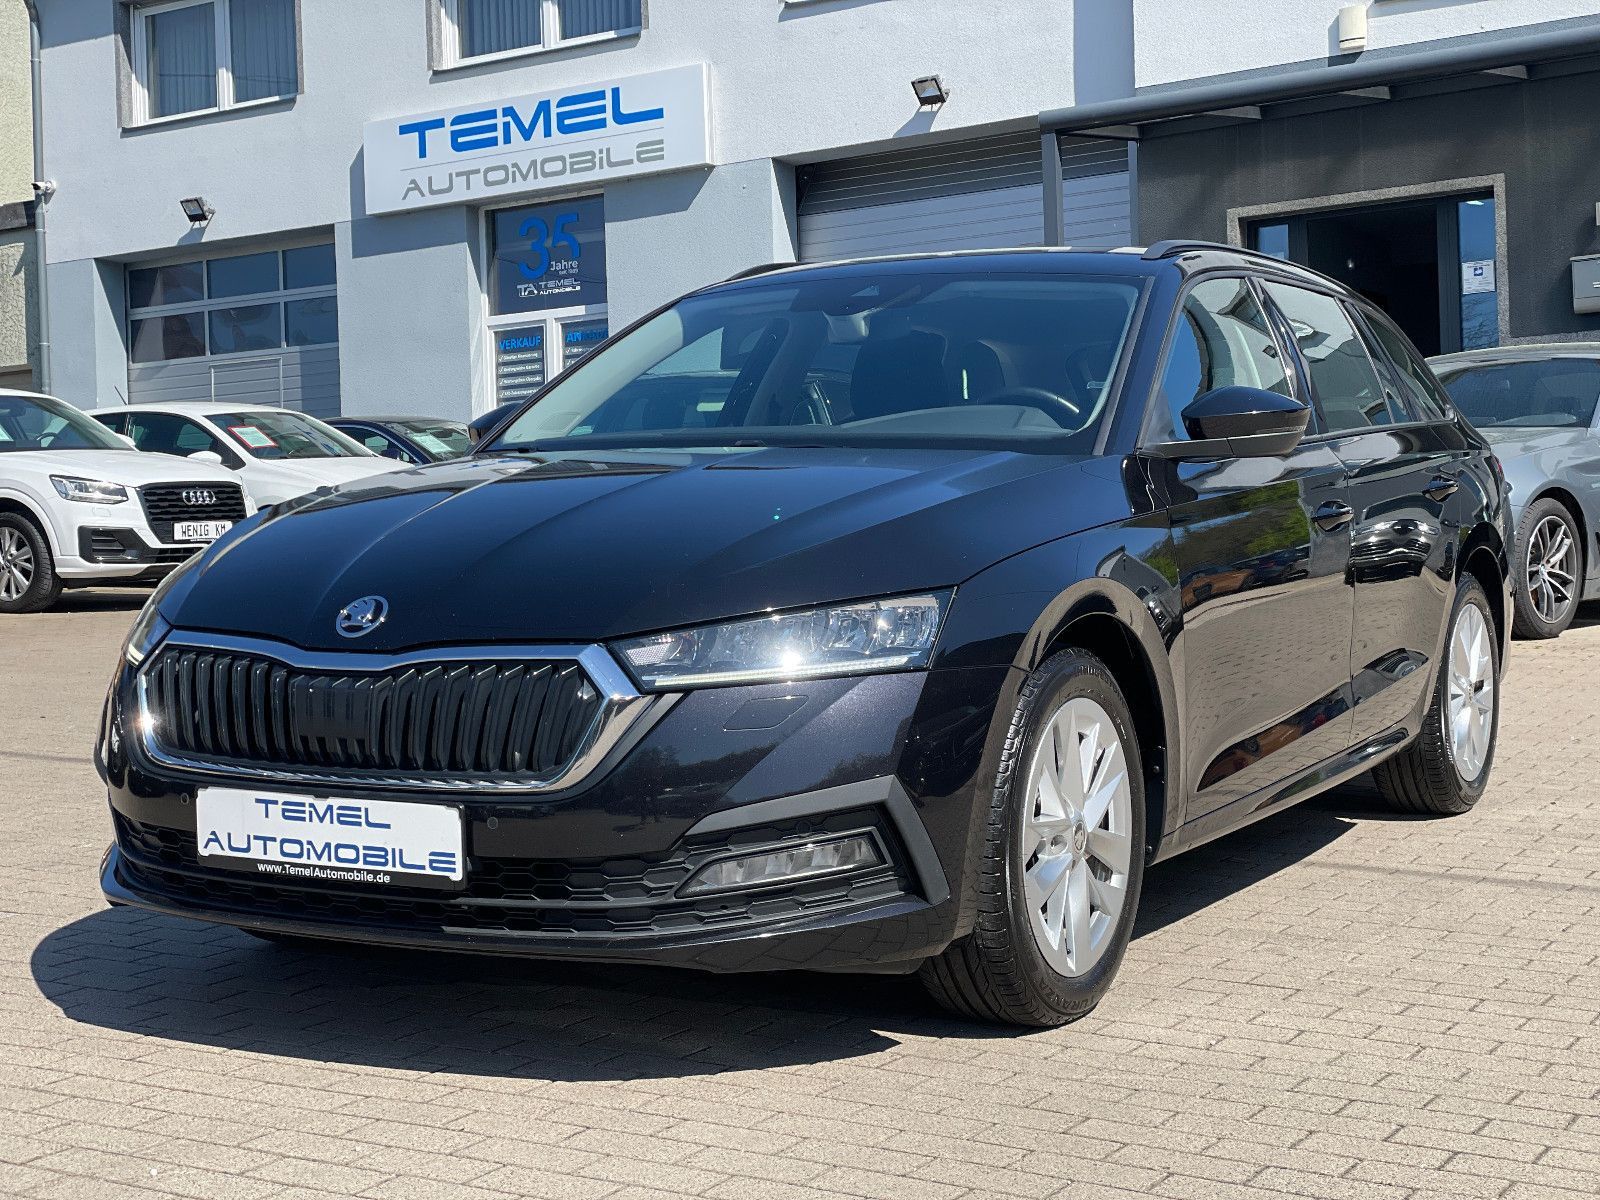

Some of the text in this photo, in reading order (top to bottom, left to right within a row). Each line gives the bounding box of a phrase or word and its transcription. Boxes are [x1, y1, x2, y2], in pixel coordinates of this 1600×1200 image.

[398, 86, 664, 159] TEMEL
[519, 212, 580, 279] 35
[550, 259, 578, 271] Jahre
[539, 277, 581, 289] TEMEL
[499, 335, 541, 350] VERKAUF
[181, 523, 226, 537] WENIG KM
[254, 797, 392, 829] TEMEL
[203, 830, 457, 874] AUTOMOBILE
[257, 862, 391, 884] www.TemelAutomobile.de
